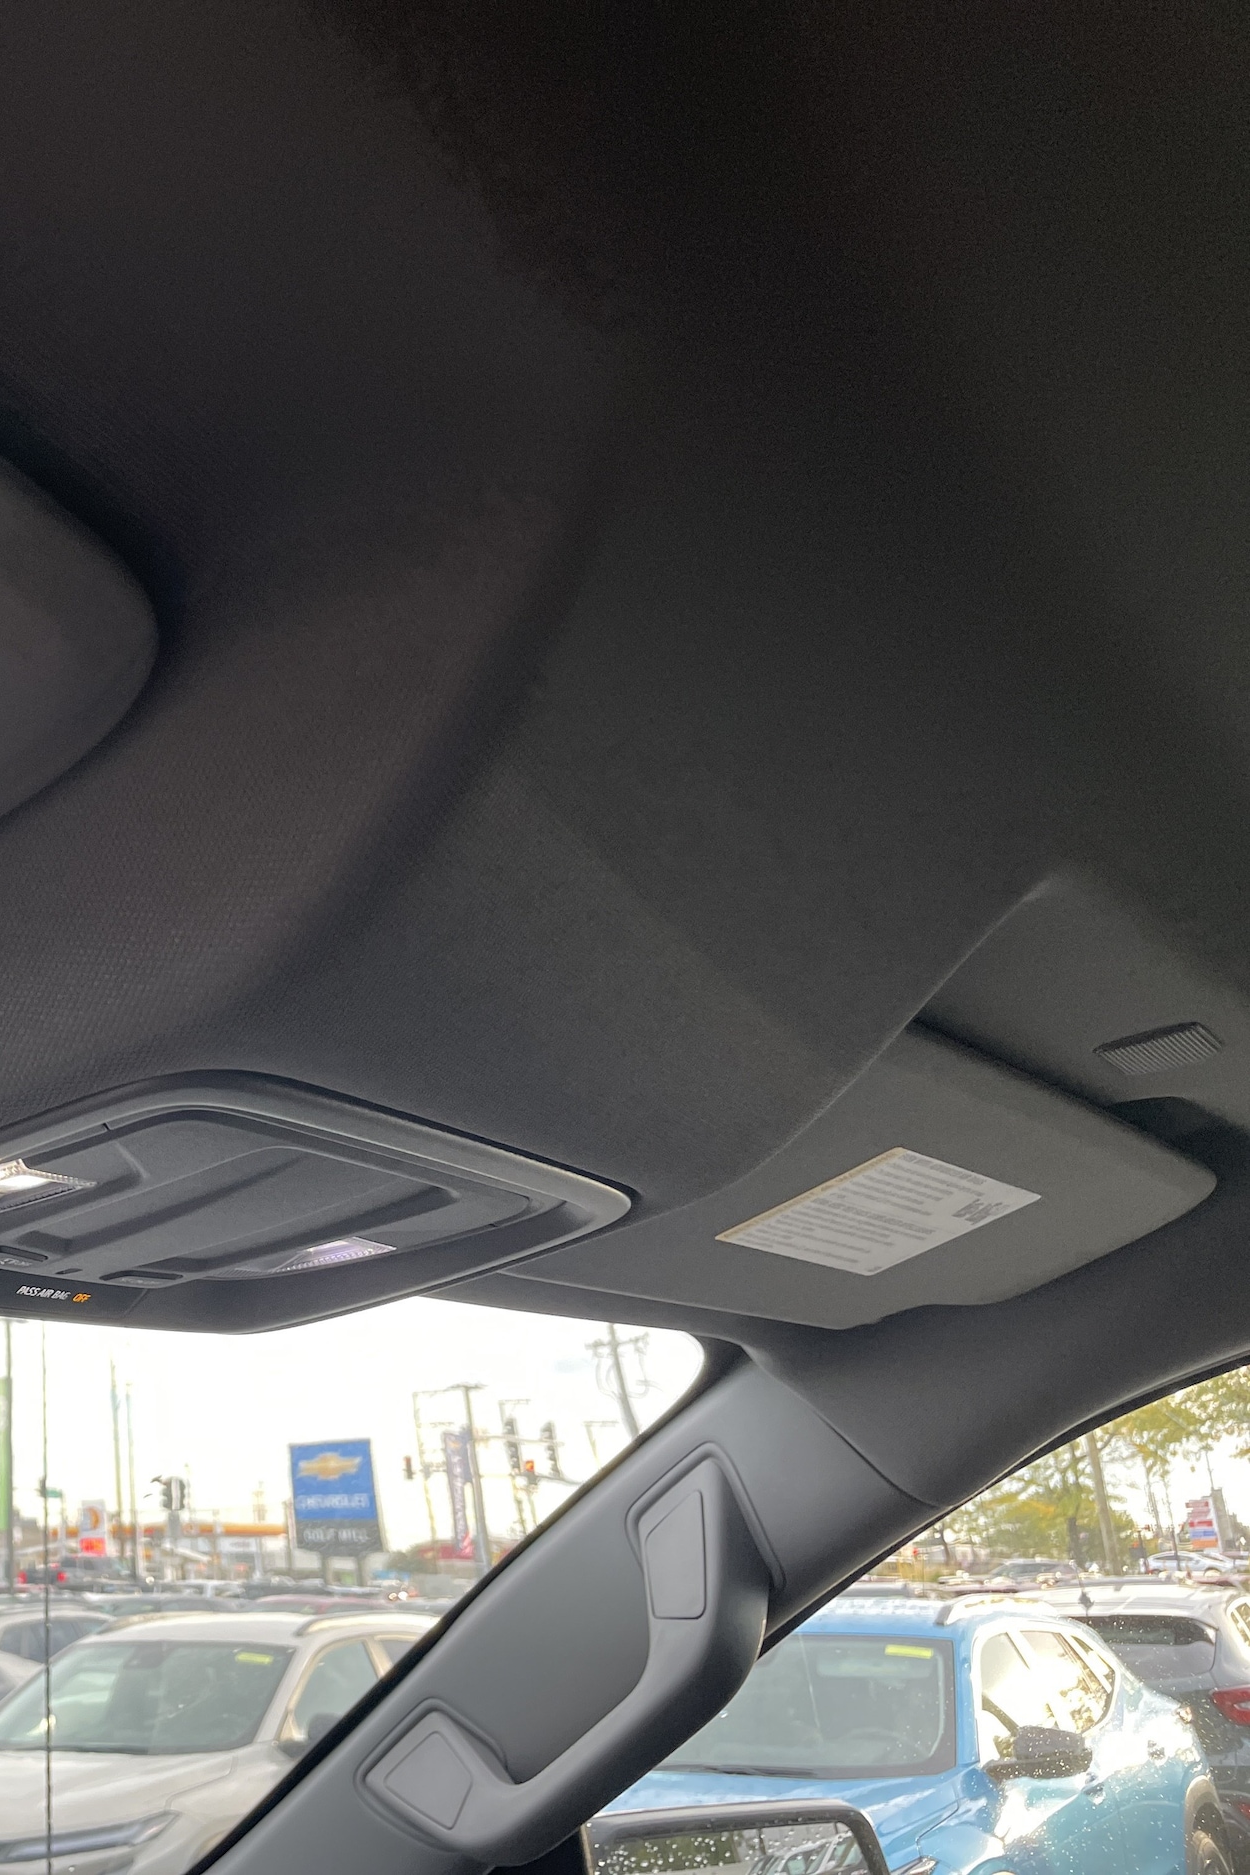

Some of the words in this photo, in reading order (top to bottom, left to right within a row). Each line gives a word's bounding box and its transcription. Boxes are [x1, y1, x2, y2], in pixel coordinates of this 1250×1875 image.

[16, 1285, 41, 1297] PASS
[36, 1288, 54, 1299] AIR
[51, 1290, 71, 1300] BAG
[72, 1293, 91, 1303] OFF
[296, 1493, 370, 1510] CHEVROLET
